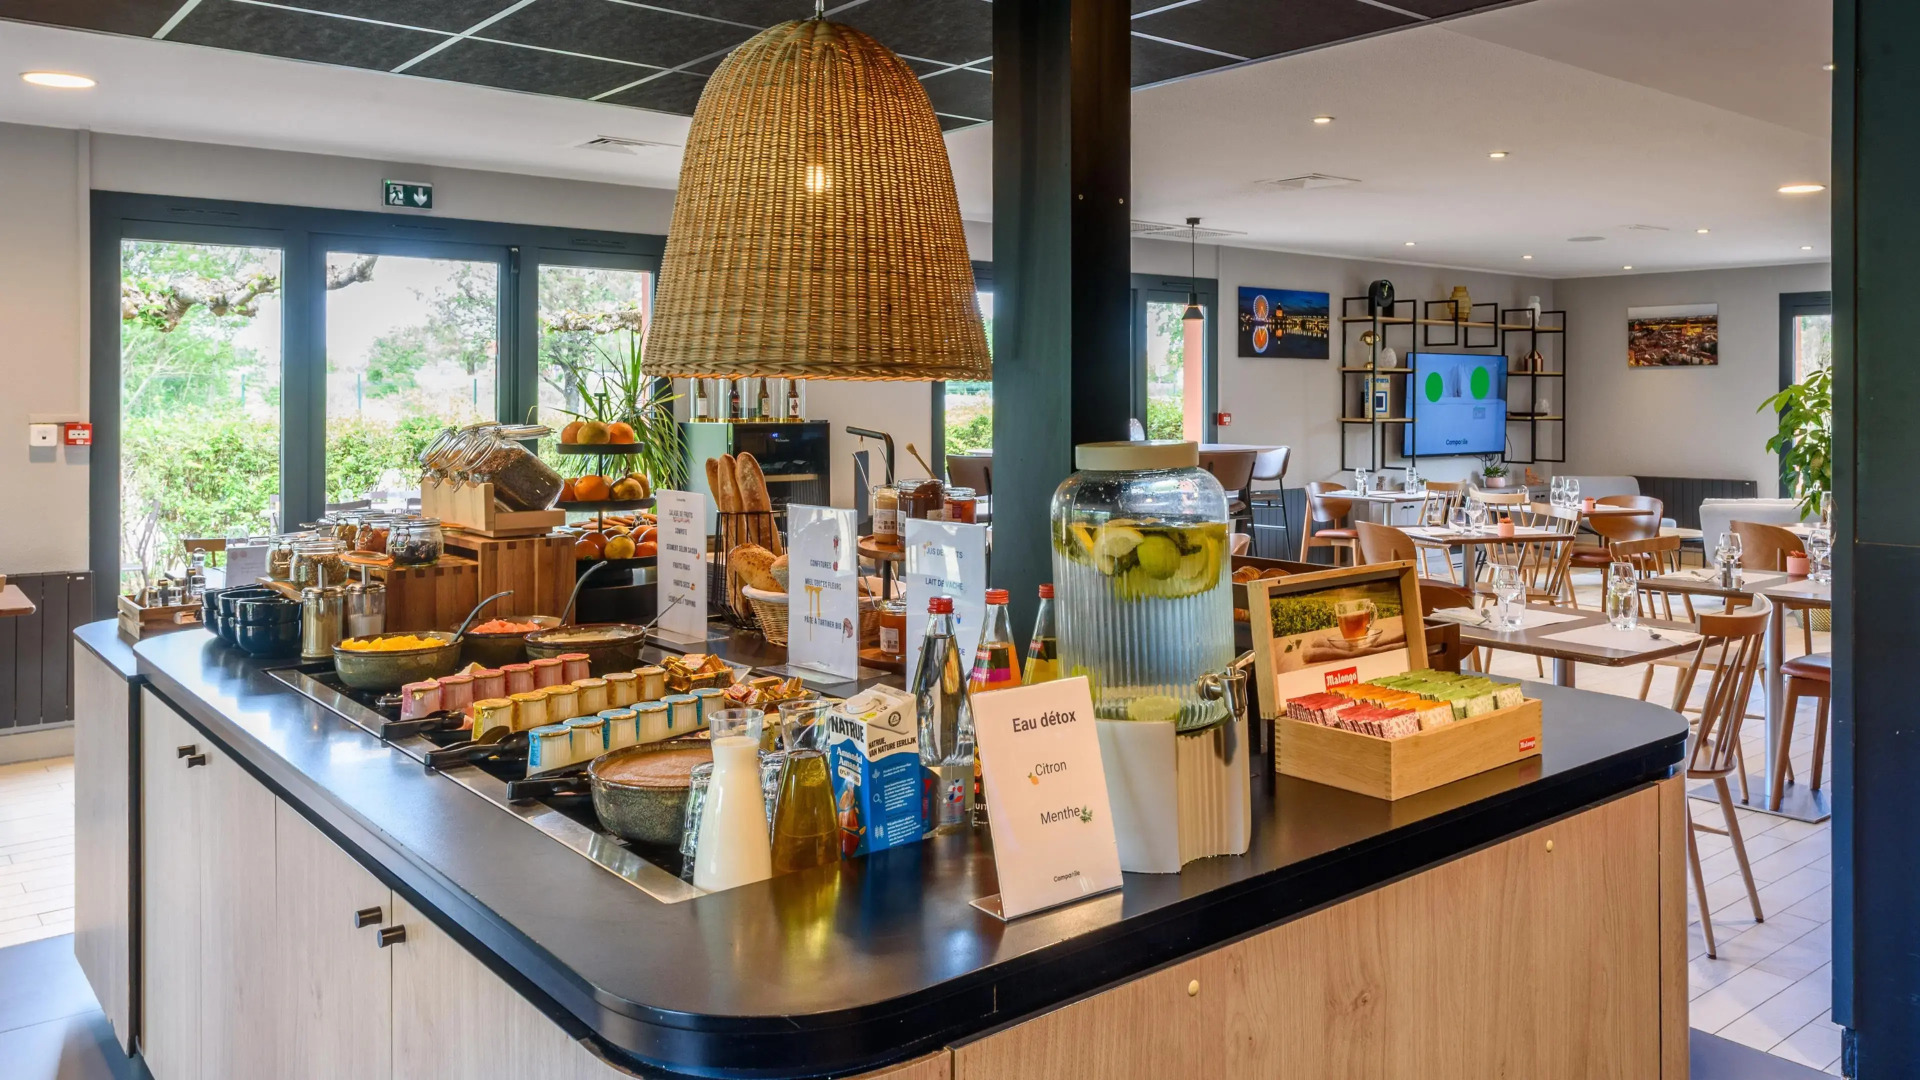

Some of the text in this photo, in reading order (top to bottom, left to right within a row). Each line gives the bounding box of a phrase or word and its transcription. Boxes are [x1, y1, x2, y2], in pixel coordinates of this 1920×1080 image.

[926, 546, 944, 556] JUS DE
[809, 559, 832, 569] CONFITURES
[804, 577, 813, 585] MIEL
[828, 581, 842, 590] FLEURS
[925, 577, 964, 591] LAIT DE VACHE
[804, 615, 814, 624] PÂTE
[818, 618, 835, 629] TARTINER
[1326, 671, 1357, 686] Malongo
[1012, 709, 1077, 733] Eau détox
[831, 716, 864, 743] NATRUE
[868, 736, 917, 758] VAN NATURE EERLIJK
[1035, 760, 1067, 776] Citron
[1040, 805, 1081, 825] Menthe
[1053, 870, 1080, 883] Campanile
